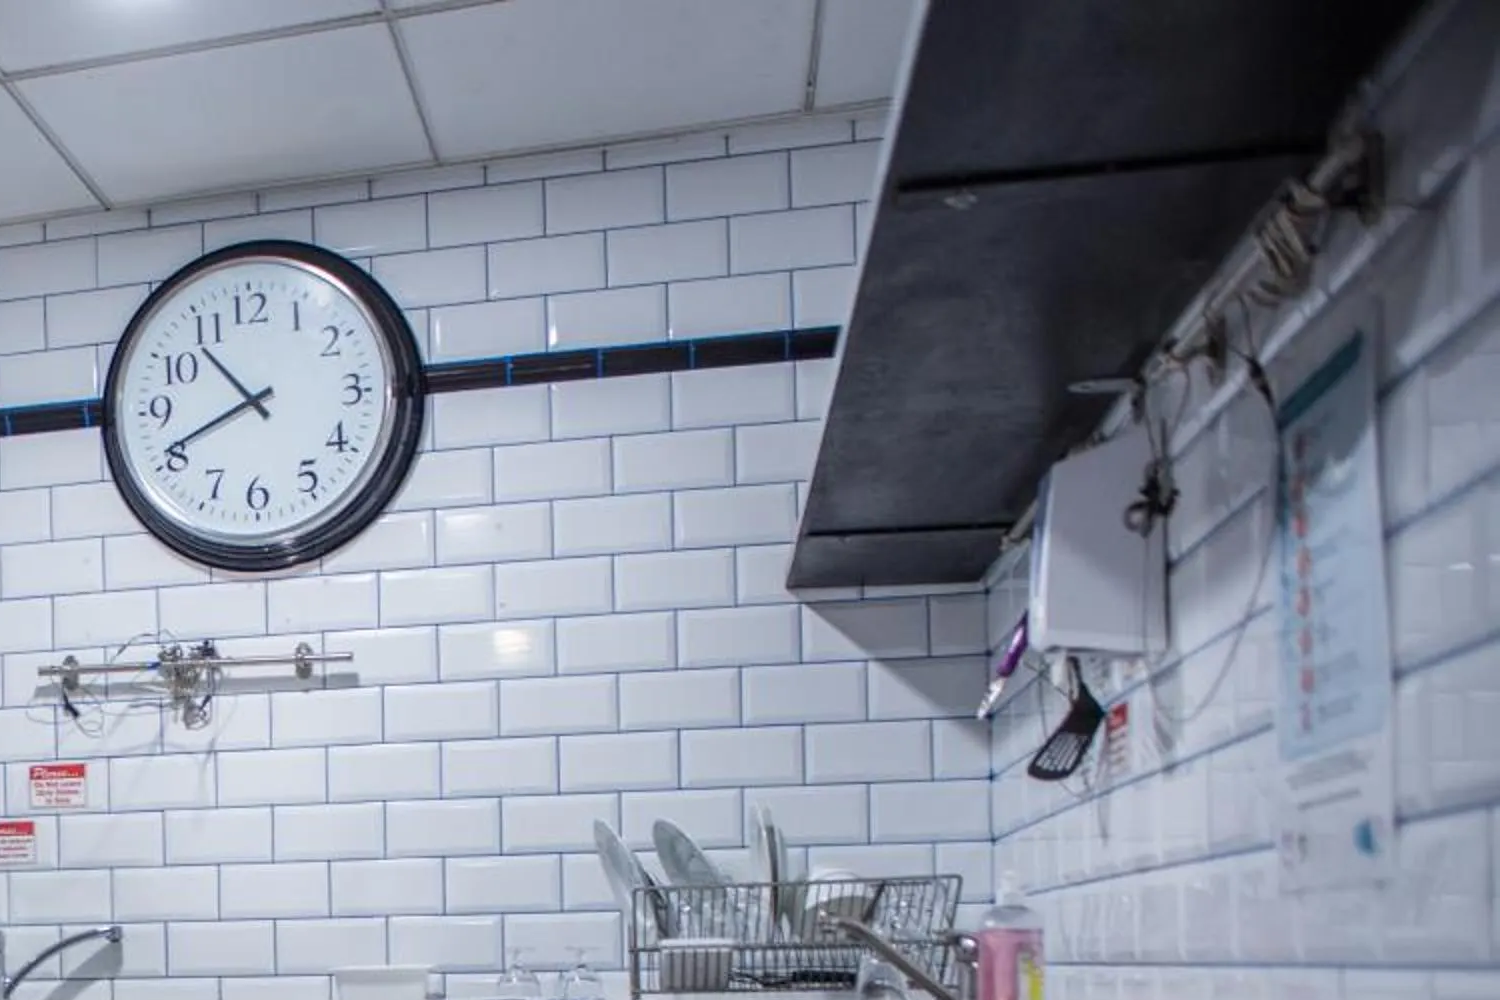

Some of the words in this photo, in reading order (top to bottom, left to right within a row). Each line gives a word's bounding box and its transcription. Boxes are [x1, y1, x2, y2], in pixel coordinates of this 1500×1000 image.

[233, 293, 268, 325] 12
[291, 300, 301, 332] 1
[196, 312, 224, 345] 11
[320, 325, 341, 357] 2
[164, 351, 198, 386] 10
[342, 373, 363, 406] 3
[149, 395, 172, 428] 9
[326, 420, 349, 453] 4
[166, 442, 189, 473] 8
[205, 468, 225, 500] 7
[298, 459, 318, 493] 5
[246, 476, 270, 510] 6
